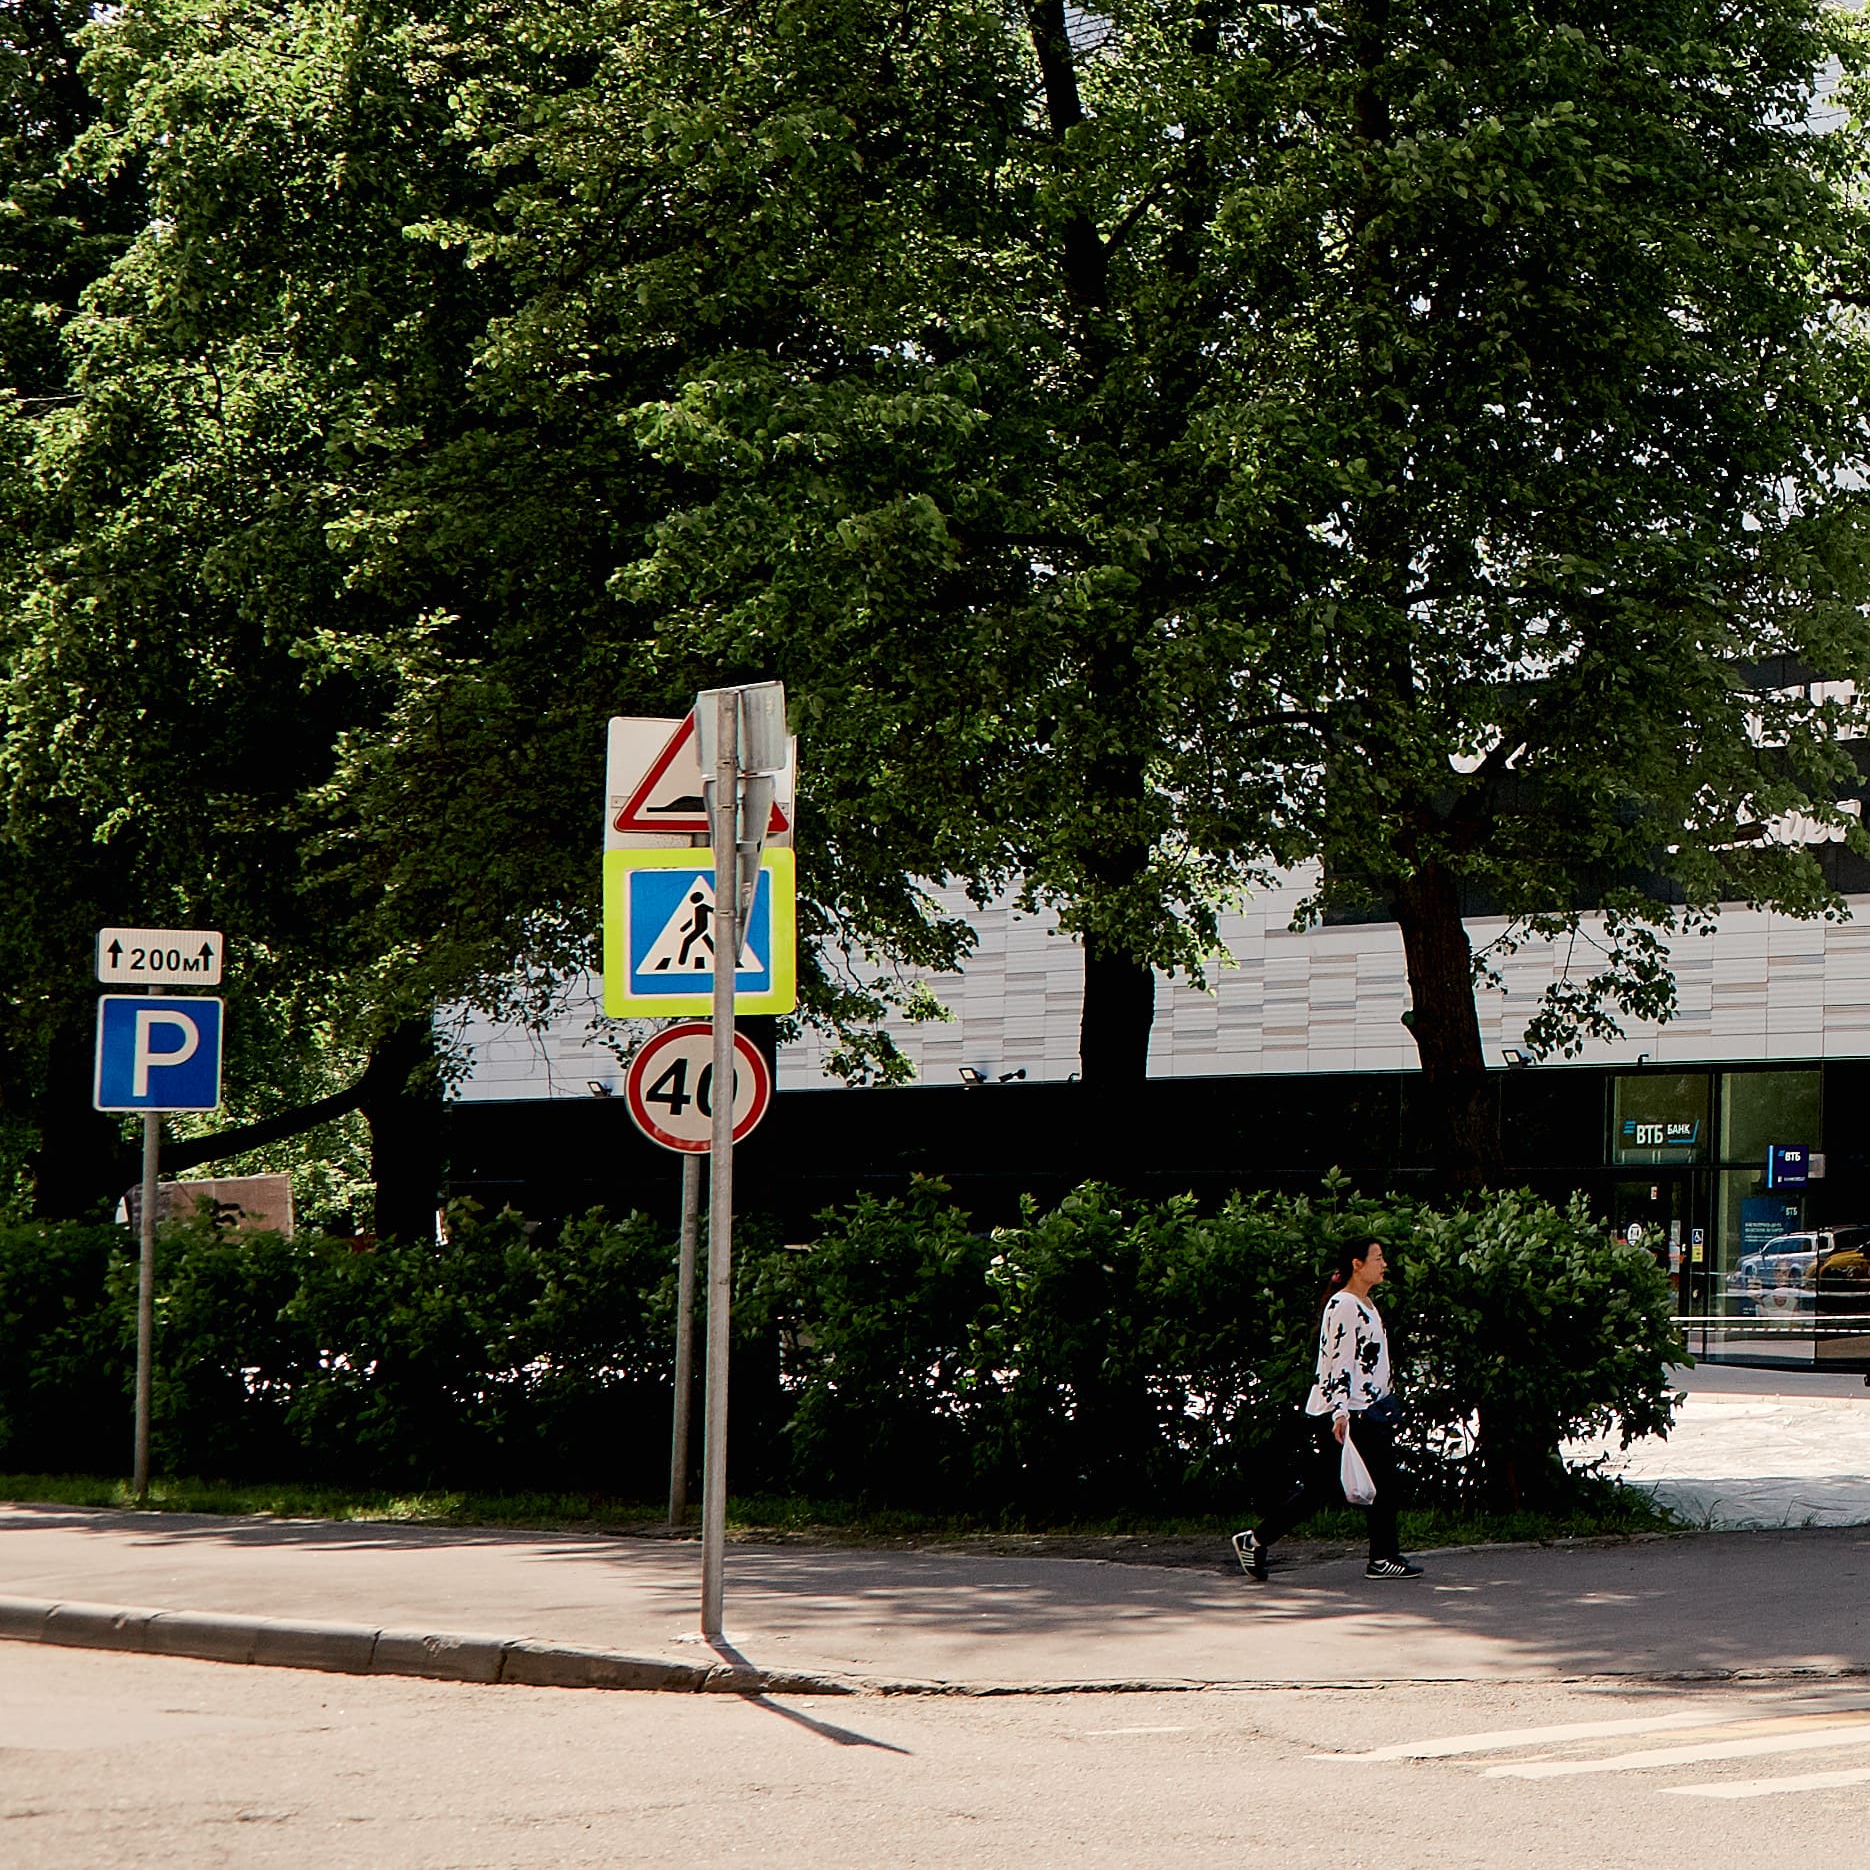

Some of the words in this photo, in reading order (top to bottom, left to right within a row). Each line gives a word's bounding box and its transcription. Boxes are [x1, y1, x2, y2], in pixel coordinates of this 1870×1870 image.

[132, 1010, 199, 1097] P
[645, 1057, 738, 1120] 40
[1636, 1124, 1664, 1144] ВТБ
[1667, 1124, 1691, 1135] БАНК
[1784, 1151, 1801, 1162] ВТБ
